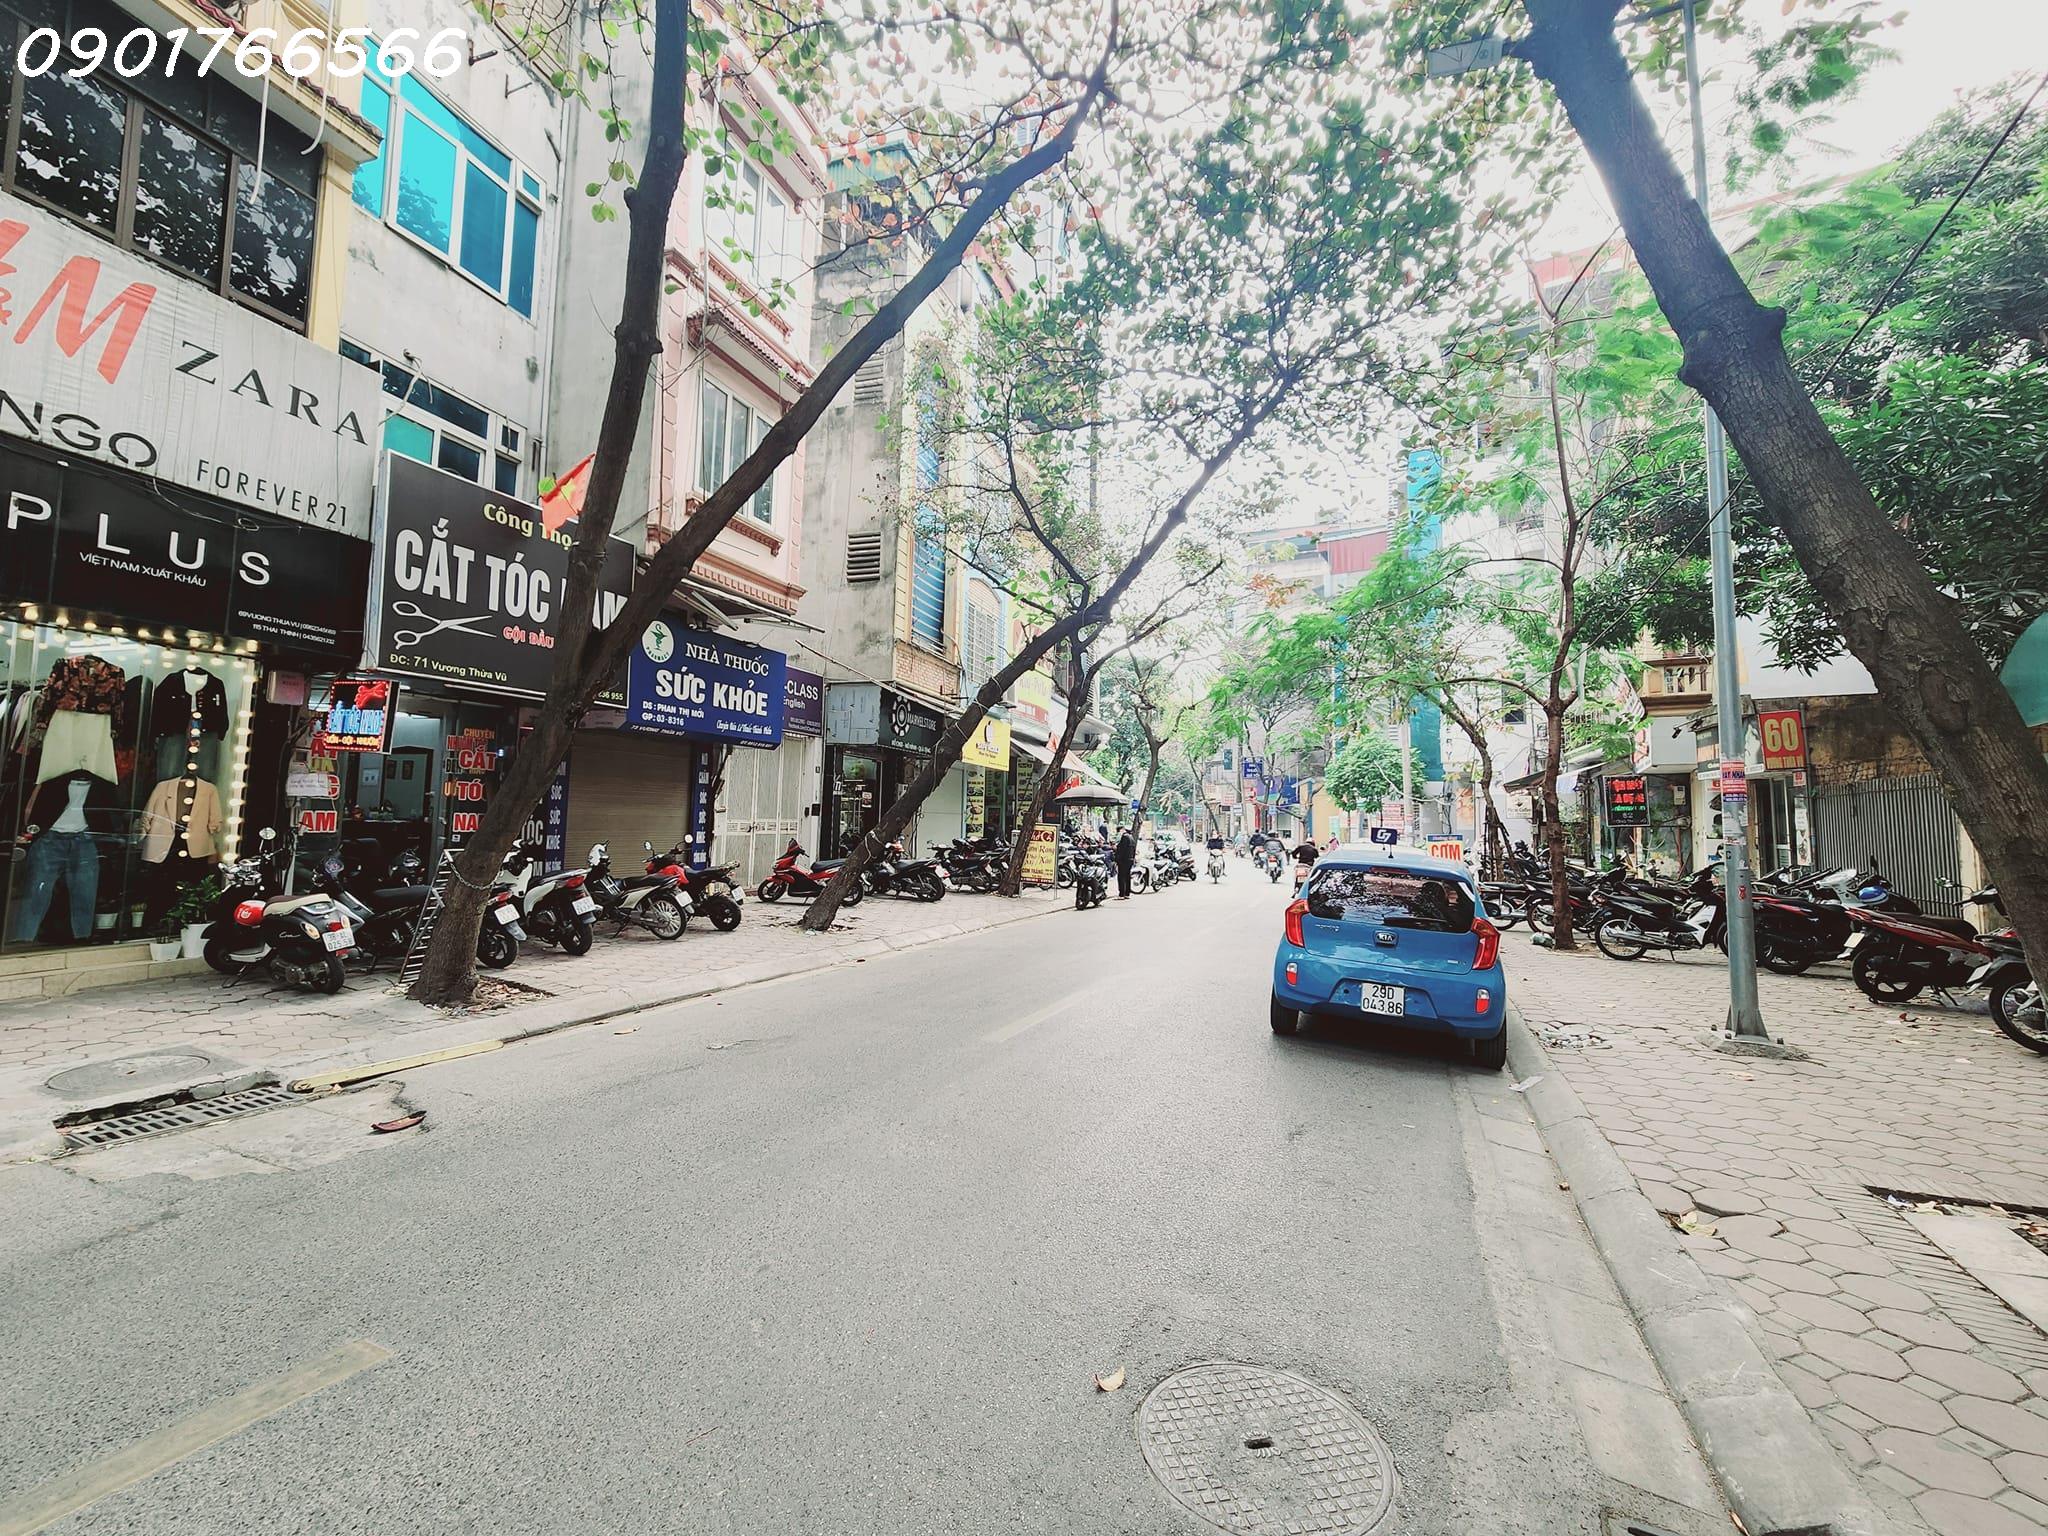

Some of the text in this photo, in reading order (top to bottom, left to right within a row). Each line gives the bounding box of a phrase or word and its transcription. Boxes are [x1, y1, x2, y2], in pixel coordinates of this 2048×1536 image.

[175, 340, 368, 446] ZARA
[197, 459, 347, 527] FOREVER 21
[483, 503, 534, 538] Công
[110, 558, 140, 573] NAM
[394, 517, 475, 604] CẮT
[485, 551, 550, 624] TÓC
[503, 626, 526, 645] GỘI
[390, 653, 411, 665] ĐC:
[413, 656, 428, 668] 71
[431, 661, 466, 676] Vương
[468, 667, 493, 679] Thừa
[686, 642, 769, 677] NHÀ THUỐC
[655, 666, 769, 716] SỨC KHỎE
[1764, 717, 1800, 753] 60
[460, 744, 497, 772] CẮT
[1431, 843, 1461, 862] CƠM
[1378, 932, 1394, 941] KIA
[1372, 985, 1395, 999] 29D
[1362, 1000, 1403, 1015] 043.86
